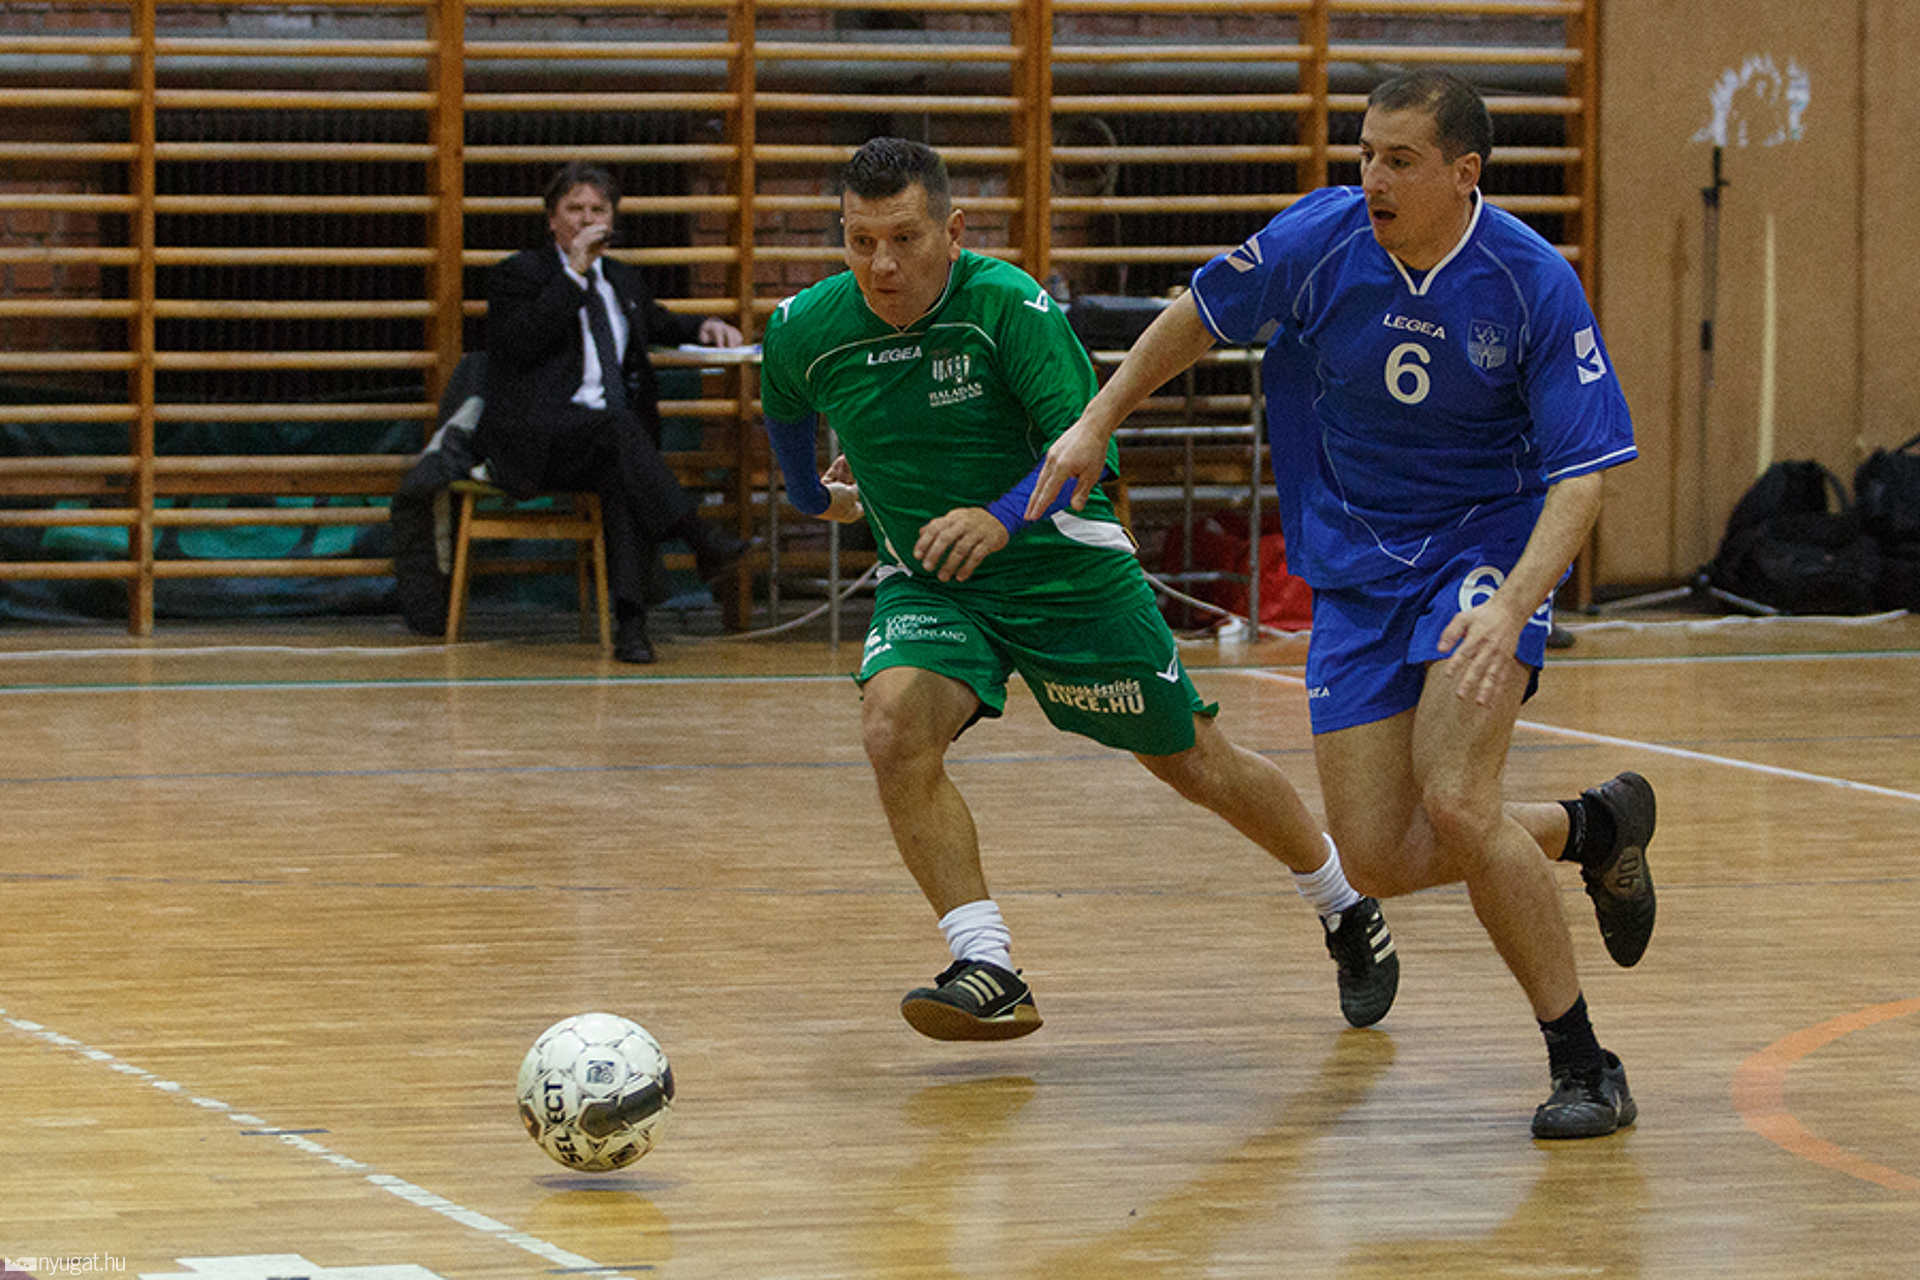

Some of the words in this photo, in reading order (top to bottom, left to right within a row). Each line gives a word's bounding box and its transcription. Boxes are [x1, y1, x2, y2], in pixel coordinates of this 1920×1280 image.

[1383, 313, 1446, 340] LEGEA
[867, 346, 923, 366] LEGEA
[1385, 342, 1431, 404] 6
[544, 1080, 584, 1164] SELECT
